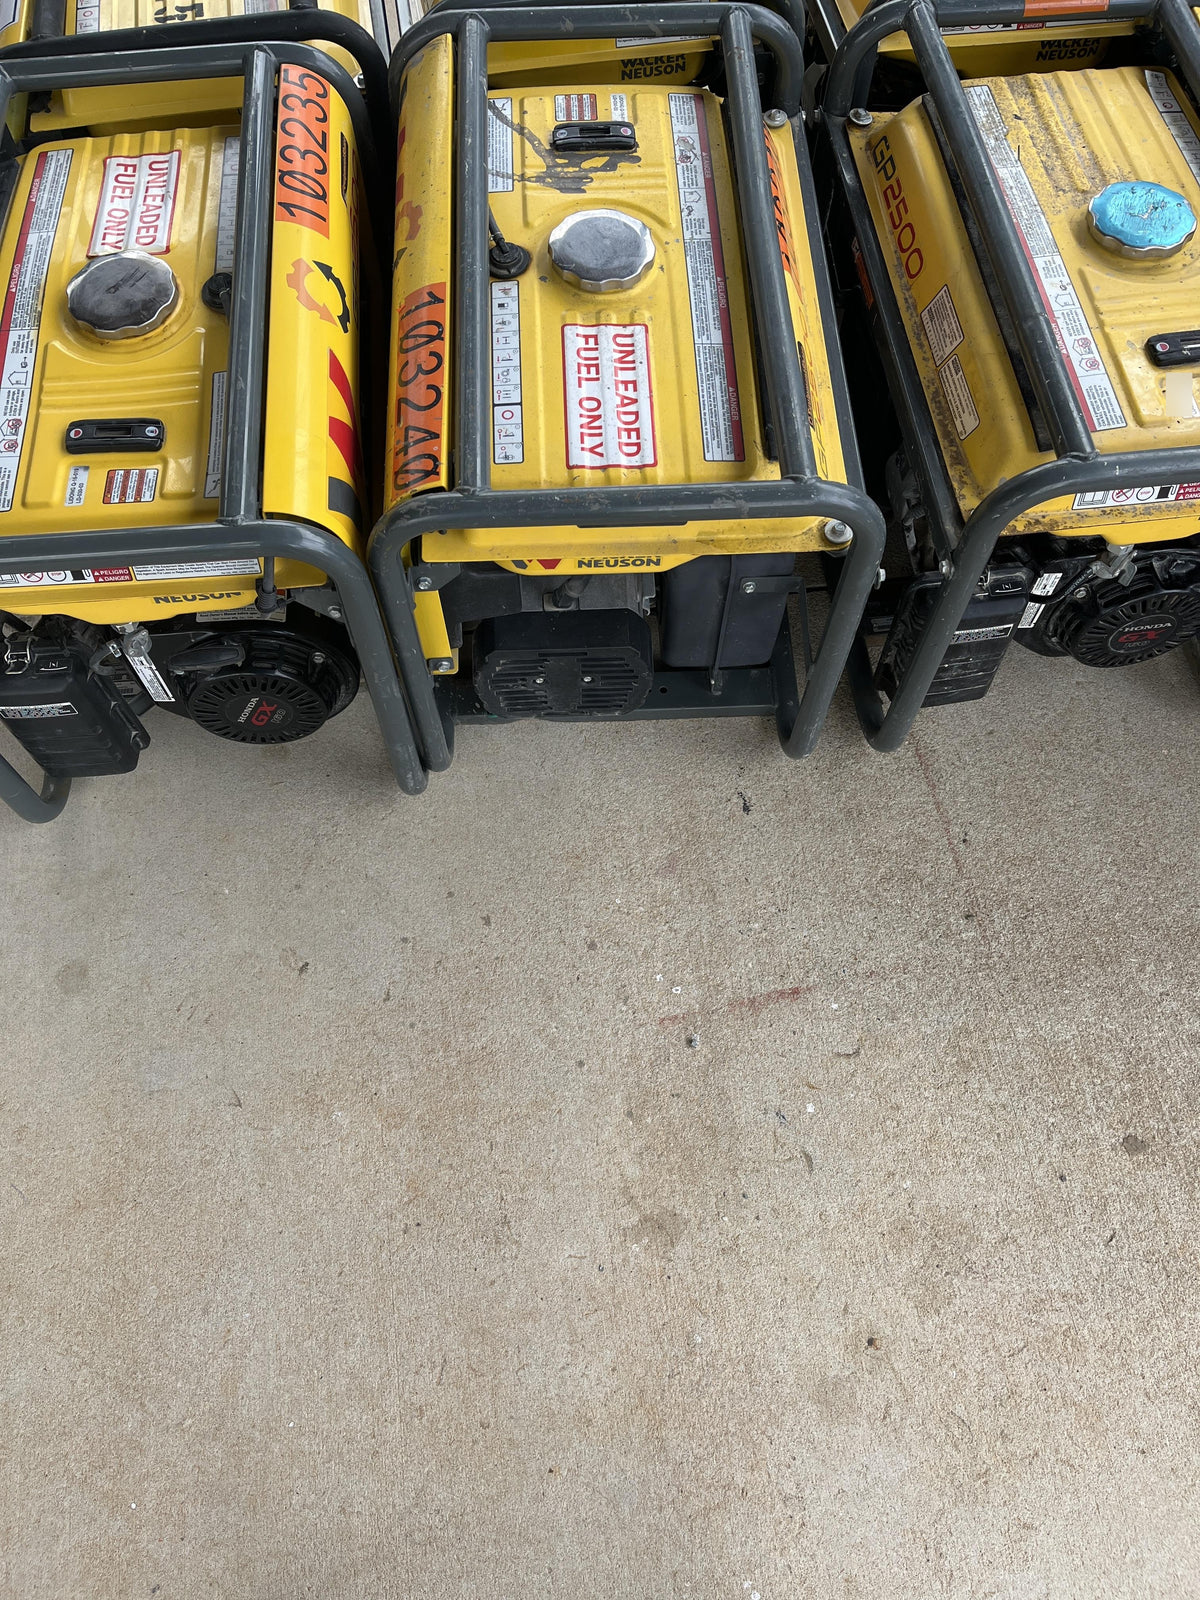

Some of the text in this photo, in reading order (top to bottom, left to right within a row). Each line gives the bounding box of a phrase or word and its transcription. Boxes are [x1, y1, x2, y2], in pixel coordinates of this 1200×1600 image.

[620, 54, 686, 69] WACKER
[1035, 46, 1099, 61] NEUSON
[621, 61, 686, 80] NEUSON
[31, 178, 41, 199] DANGER
[100, 162, 137, 250] FUEL ONLY
[135, 159, 170, 246] UNLEADED
[873, 135, 924, 279] GP2500
[11, 264, 21, 289] PELIGRO
[716, 281, 728, 309] PELIGRO
[576, 333, 605, 458] FUEL ONLY
[612, 332, 642, 458] UNLEADED
[729, 393, 739, 421] DANGER
[100, 568, 129, 576] PELIGRO
[577, 558, 662, 568] NEUSON
[1118, 629, 1167, 643] GX
[1123, 622, 1172, 632] HONDA
[237, 696, 260, 723] HONDA
[250, 700, 278, 726] GX
